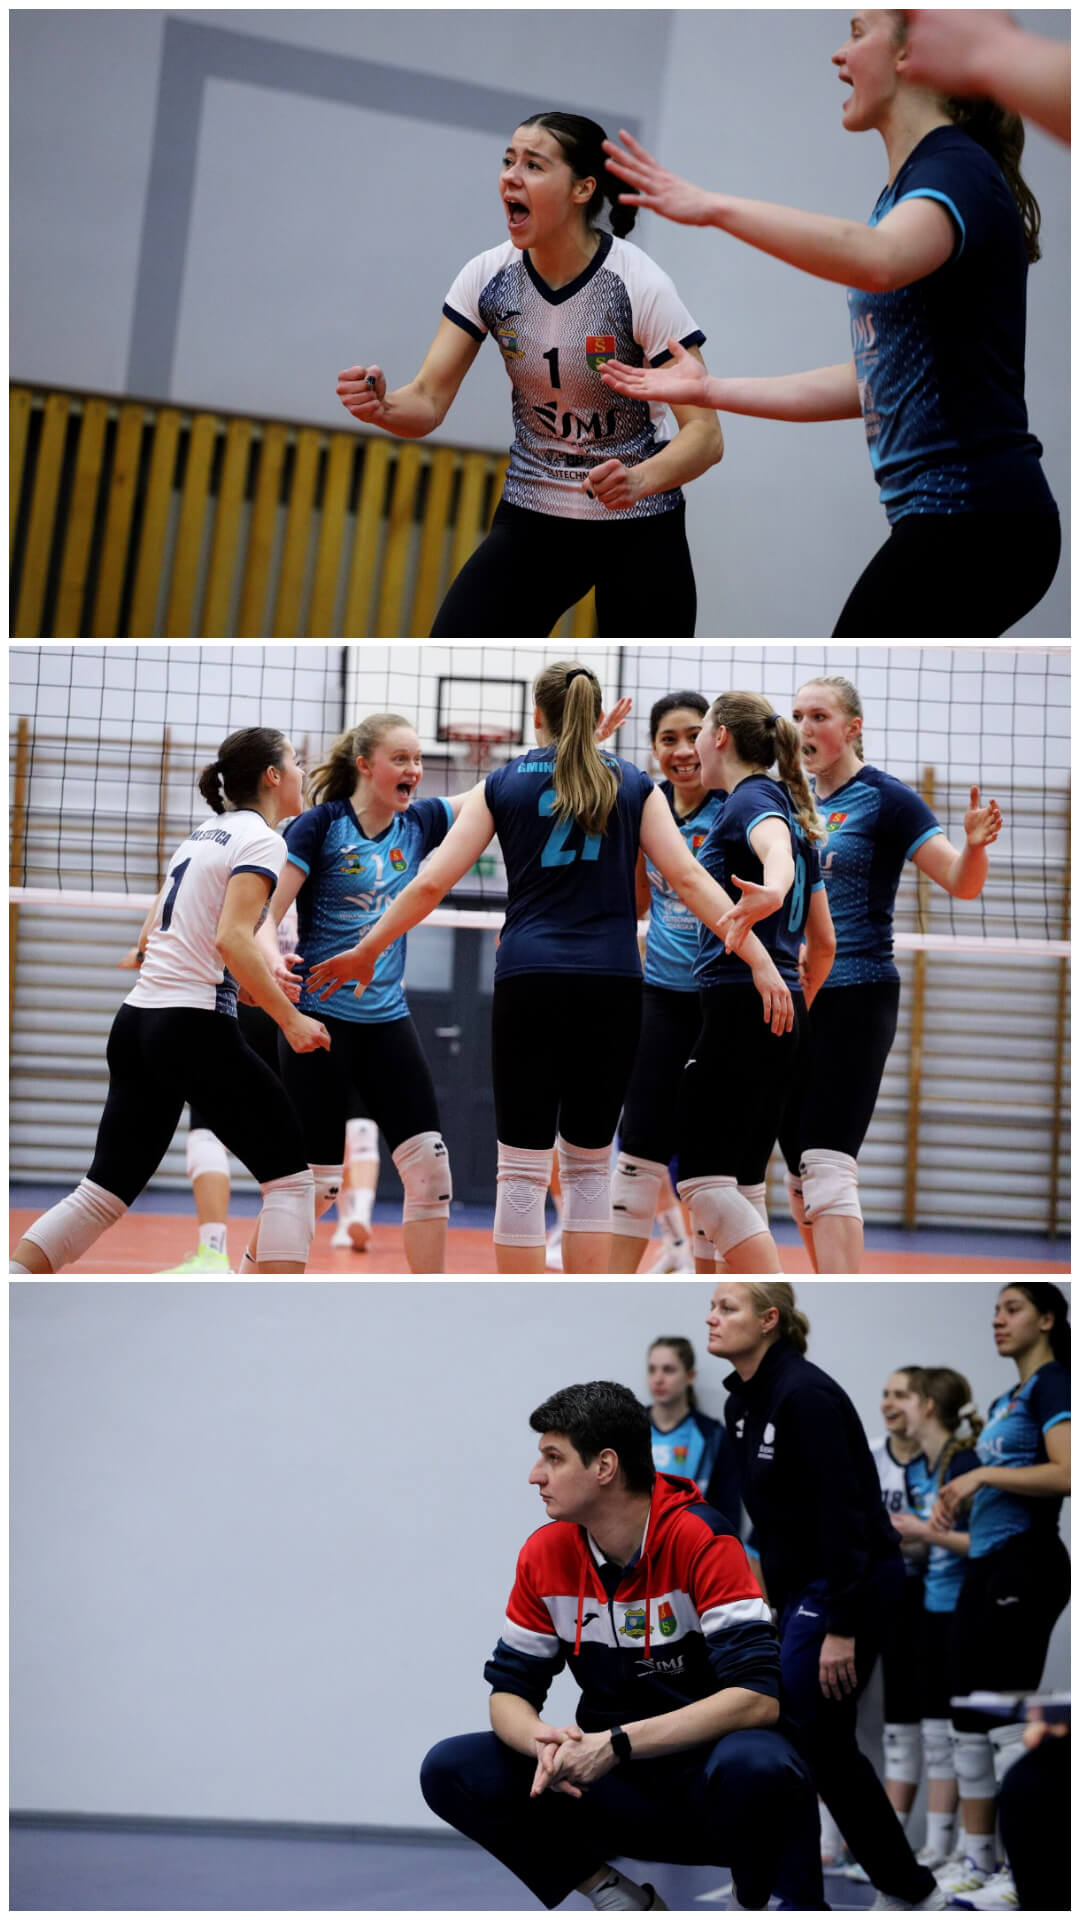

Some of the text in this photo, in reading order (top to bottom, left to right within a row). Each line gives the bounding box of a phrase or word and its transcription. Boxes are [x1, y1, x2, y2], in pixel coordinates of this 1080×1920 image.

[853, 313, 876, 350] MS
[543, 347, 561, 389] 1
[561, 407, 619, 439] SMS
[517, 761, 556, 773] GMIN
[371, 853, 384, 880] 1
[160, 857, 192, 931] 1
[881, 1490, 903, 1512] 18
